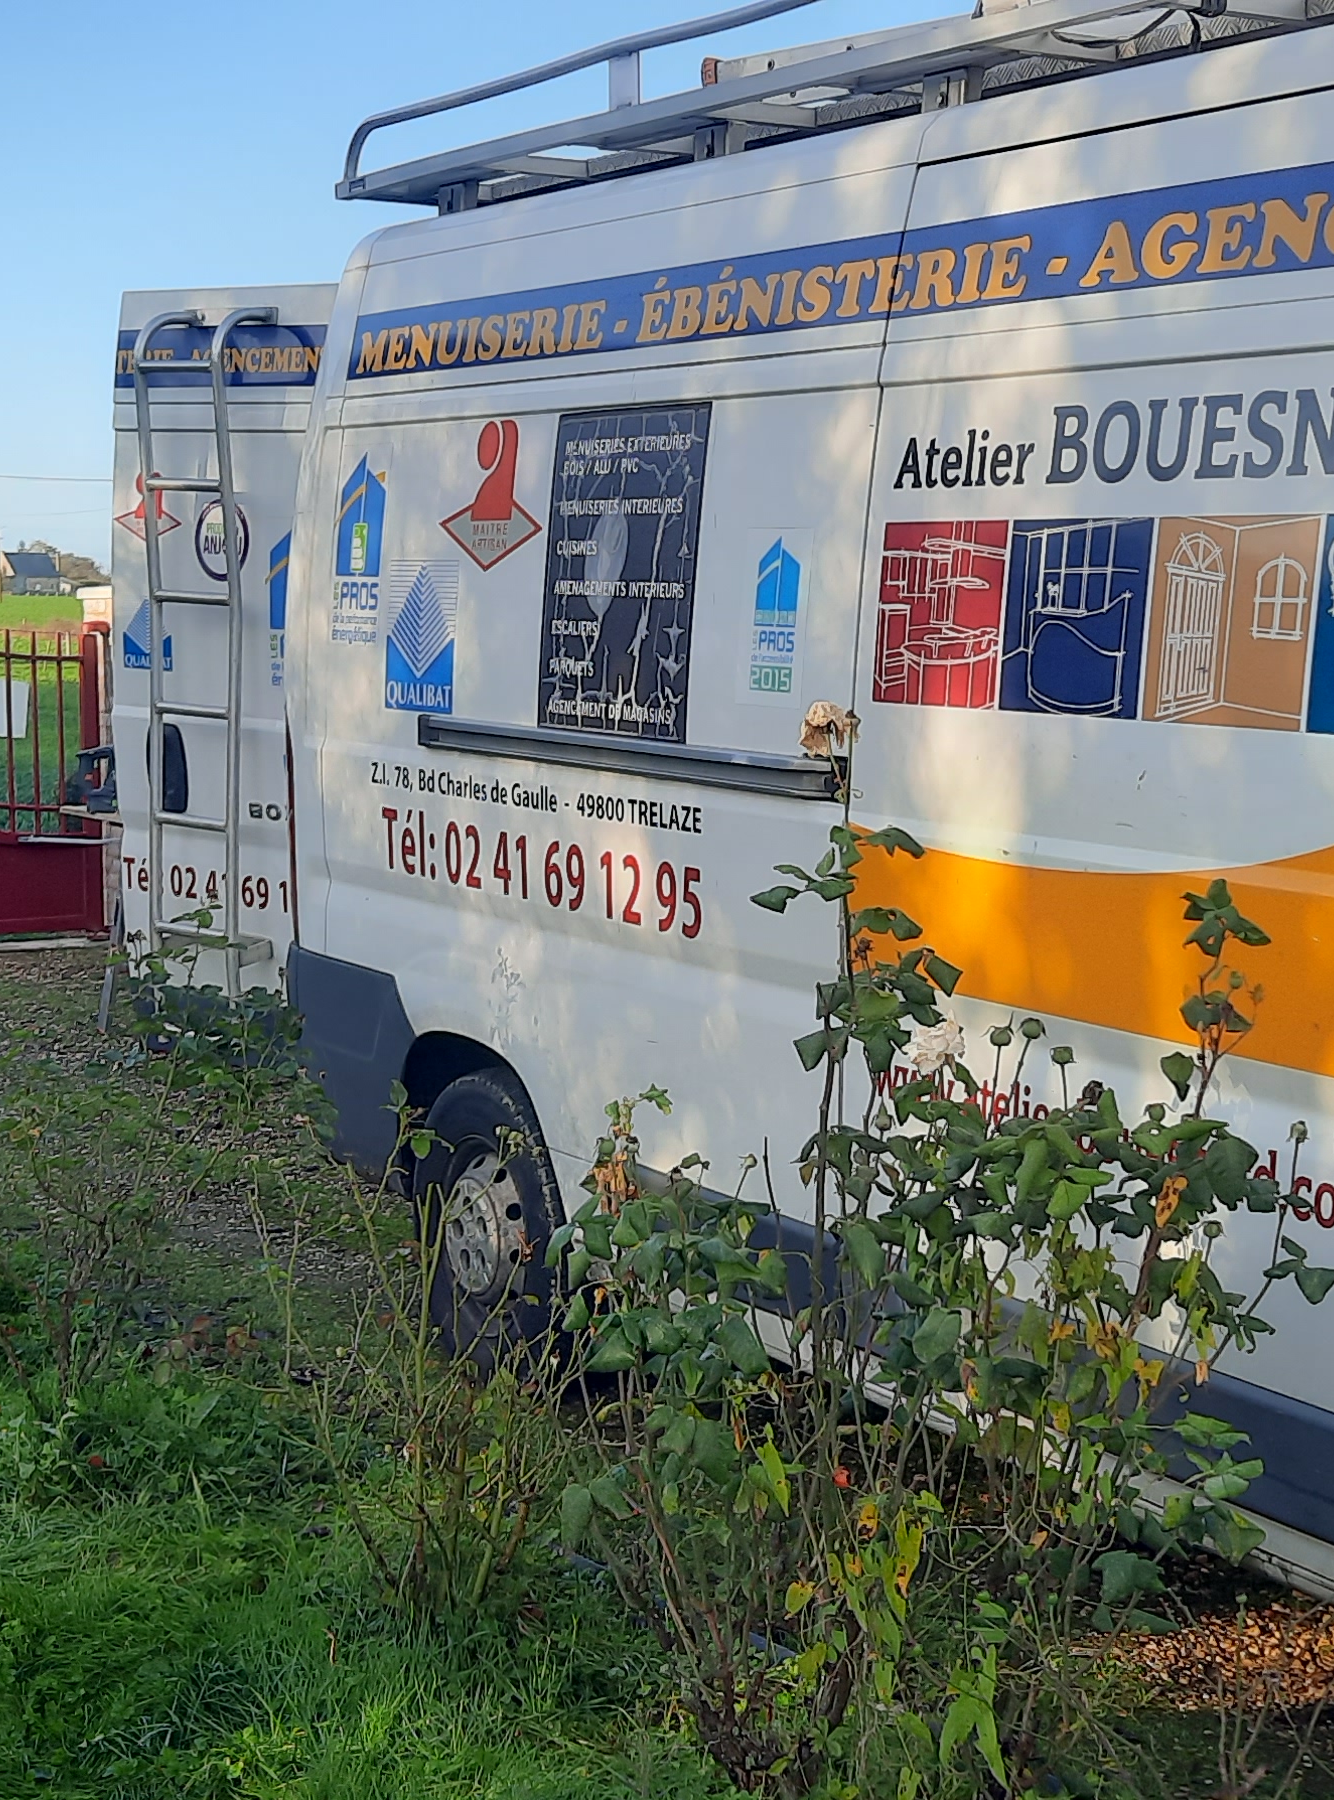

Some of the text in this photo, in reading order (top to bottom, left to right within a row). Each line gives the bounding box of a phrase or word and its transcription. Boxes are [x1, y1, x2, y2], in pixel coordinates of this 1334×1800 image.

[356, 298, 606, 375] MENUISERIE
[636, 236, 1032, 344] ÉBÉNISTERIE
[565, 433, 692, 456] MENUISERIES EXTERIEURES
[563, 458, 585, 476] BOIS
[593, 458, 612, 475] ALU
[621, 457, 640, 474] PVC
[893, 428, 1035, 490] Atelier
[559, 497, 684, 517] MENUISERIES INTERIEURES
[472, 522, 509, 536] MAITRE
[471, 538, 507, 551] ARTISAN
[556, 540, 598, 557] CUISINES
[340, 581, 379, 611] PROS
[553, 580, 685, 599] AMENAGEMENTS INTERIEURS
[551, 619, 599, 636] ESCALIERS
[758, 630, 795, 652] PROS
[549, 658, 594, 677] PARQUETS
[750, 667, 790, 691] 2015
[386, 680, 451, 708] QUALIBAT
[547, 699, 607, 718] AGENCEMENT
[623, 706, 671, 724] MAGASINS
[371, 762, 390, 786] Z.I.
[394, 765, 413, 793] 78,
[418, 769, 435, 793] Bd
[438, 772, 487, 802] Charles
[490, 780, 508, 805] de
[511, 783, 558, 812] Gaulle
[576, 793, 624, 823] 49800
[628, 799, 702, 834] TRELAZE
[382, 806, 702, 939] Tél: 02 41 69 12 95
[170, 864, 198, 899] 02
[241, 875, 268, 910] 69
